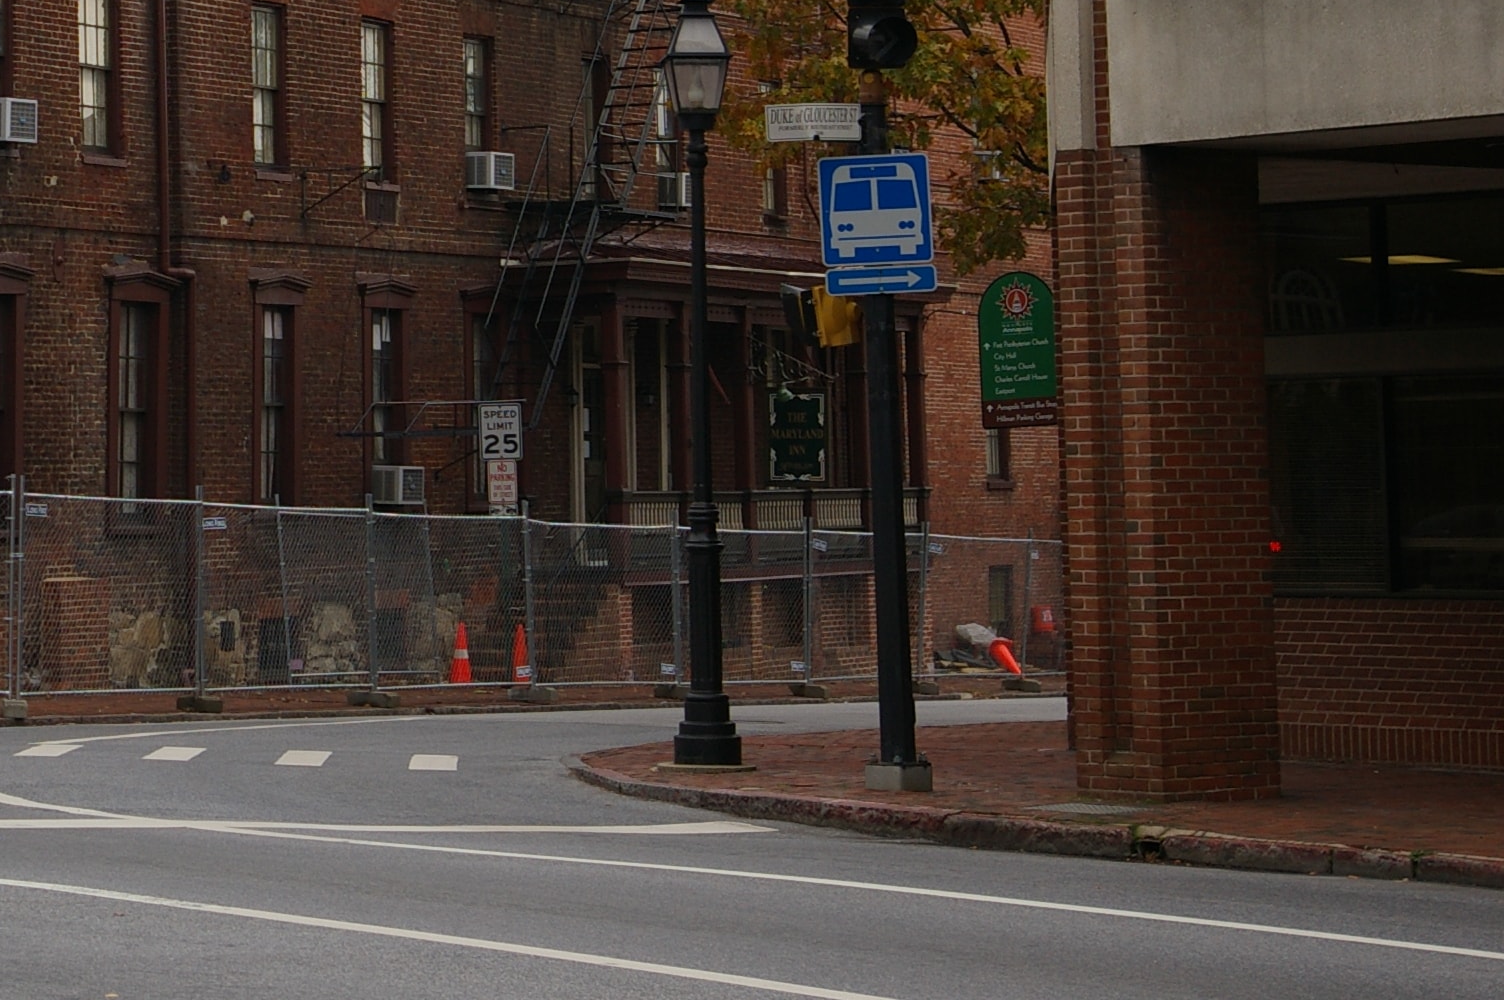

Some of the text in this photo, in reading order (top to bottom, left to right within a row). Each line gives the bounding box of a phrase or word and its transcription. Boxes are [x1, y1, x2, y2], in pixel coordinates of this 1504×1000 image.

[770, 108, 794, 124] DUKE
[795, 110, 804, 123] of
[804, 107, 847, 123] GLOUCESTER
[993, 352, 1017, 361] City Hall
[483, 409, 517, 419] SPEED
[787, 412, 808, 423] THE
[487, 421, 514, 431] LIMIT
[769, 429, 825, 440] MARYLAND
[484, 433, 518, 454] 25
[789, 445, 807, 456] INN
[497, 463, 508, 473] NO
[490, 473, 516, 482] PARKING
